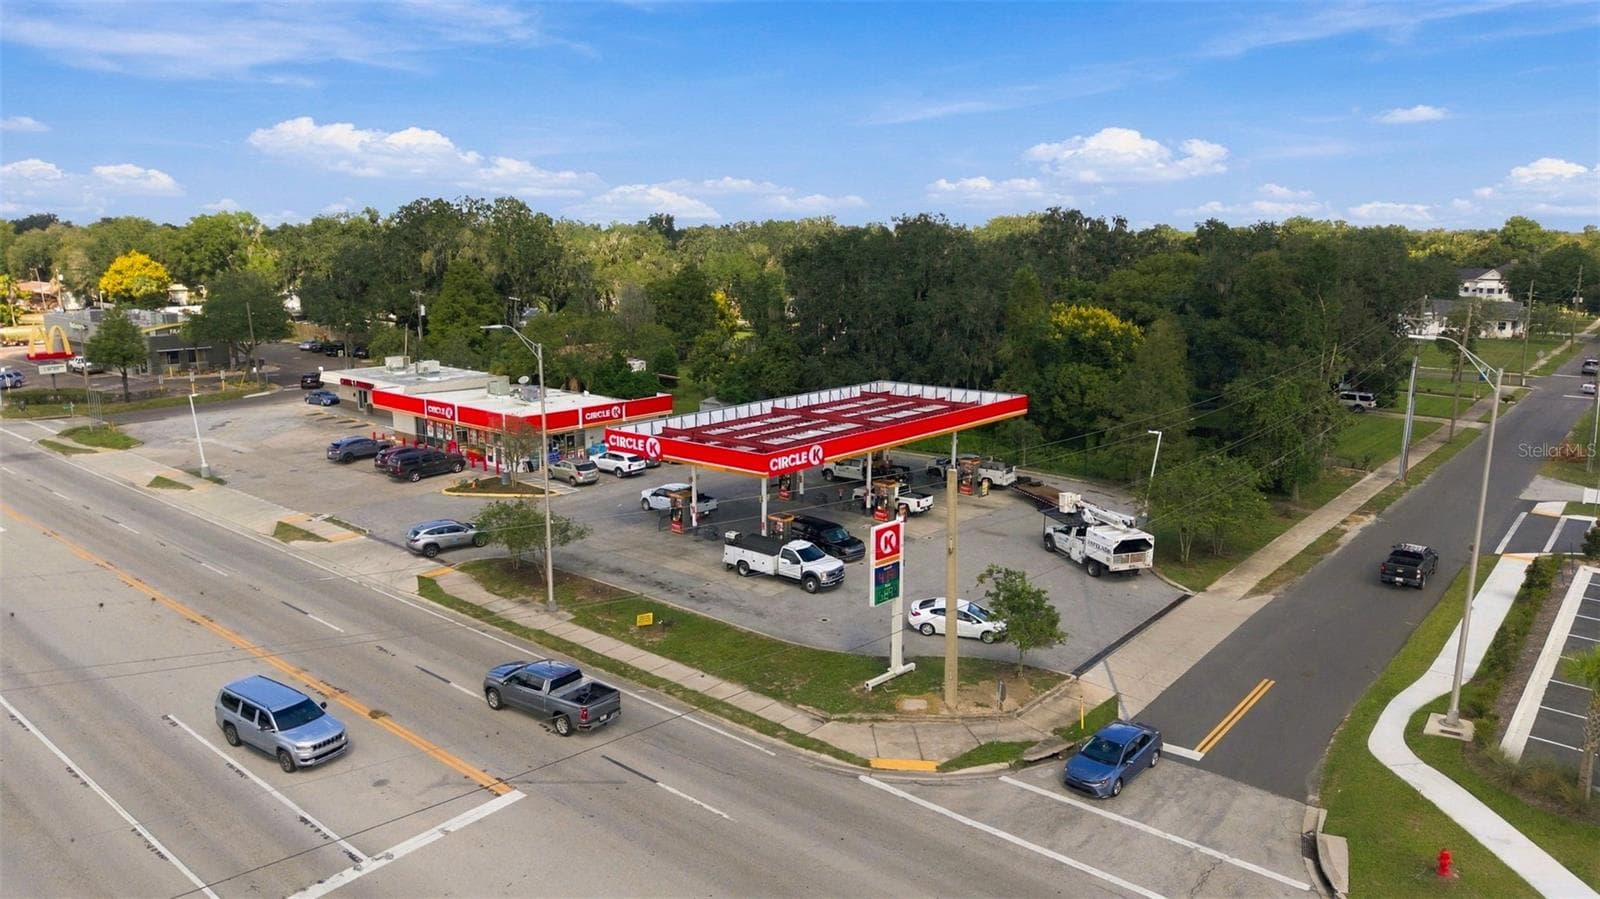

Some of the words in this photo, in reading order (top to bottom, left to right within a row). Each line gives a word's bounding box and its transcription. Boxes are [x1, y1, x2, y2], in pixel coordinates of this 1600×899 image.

[585, 409, 610, 420] CIRCLE
[609, 434, 645, 451] CIRCLE
[646, 438, 660, 457] K
[769, 451, 808, 471] CIRCLE
[809, 445, 823, 464] K
